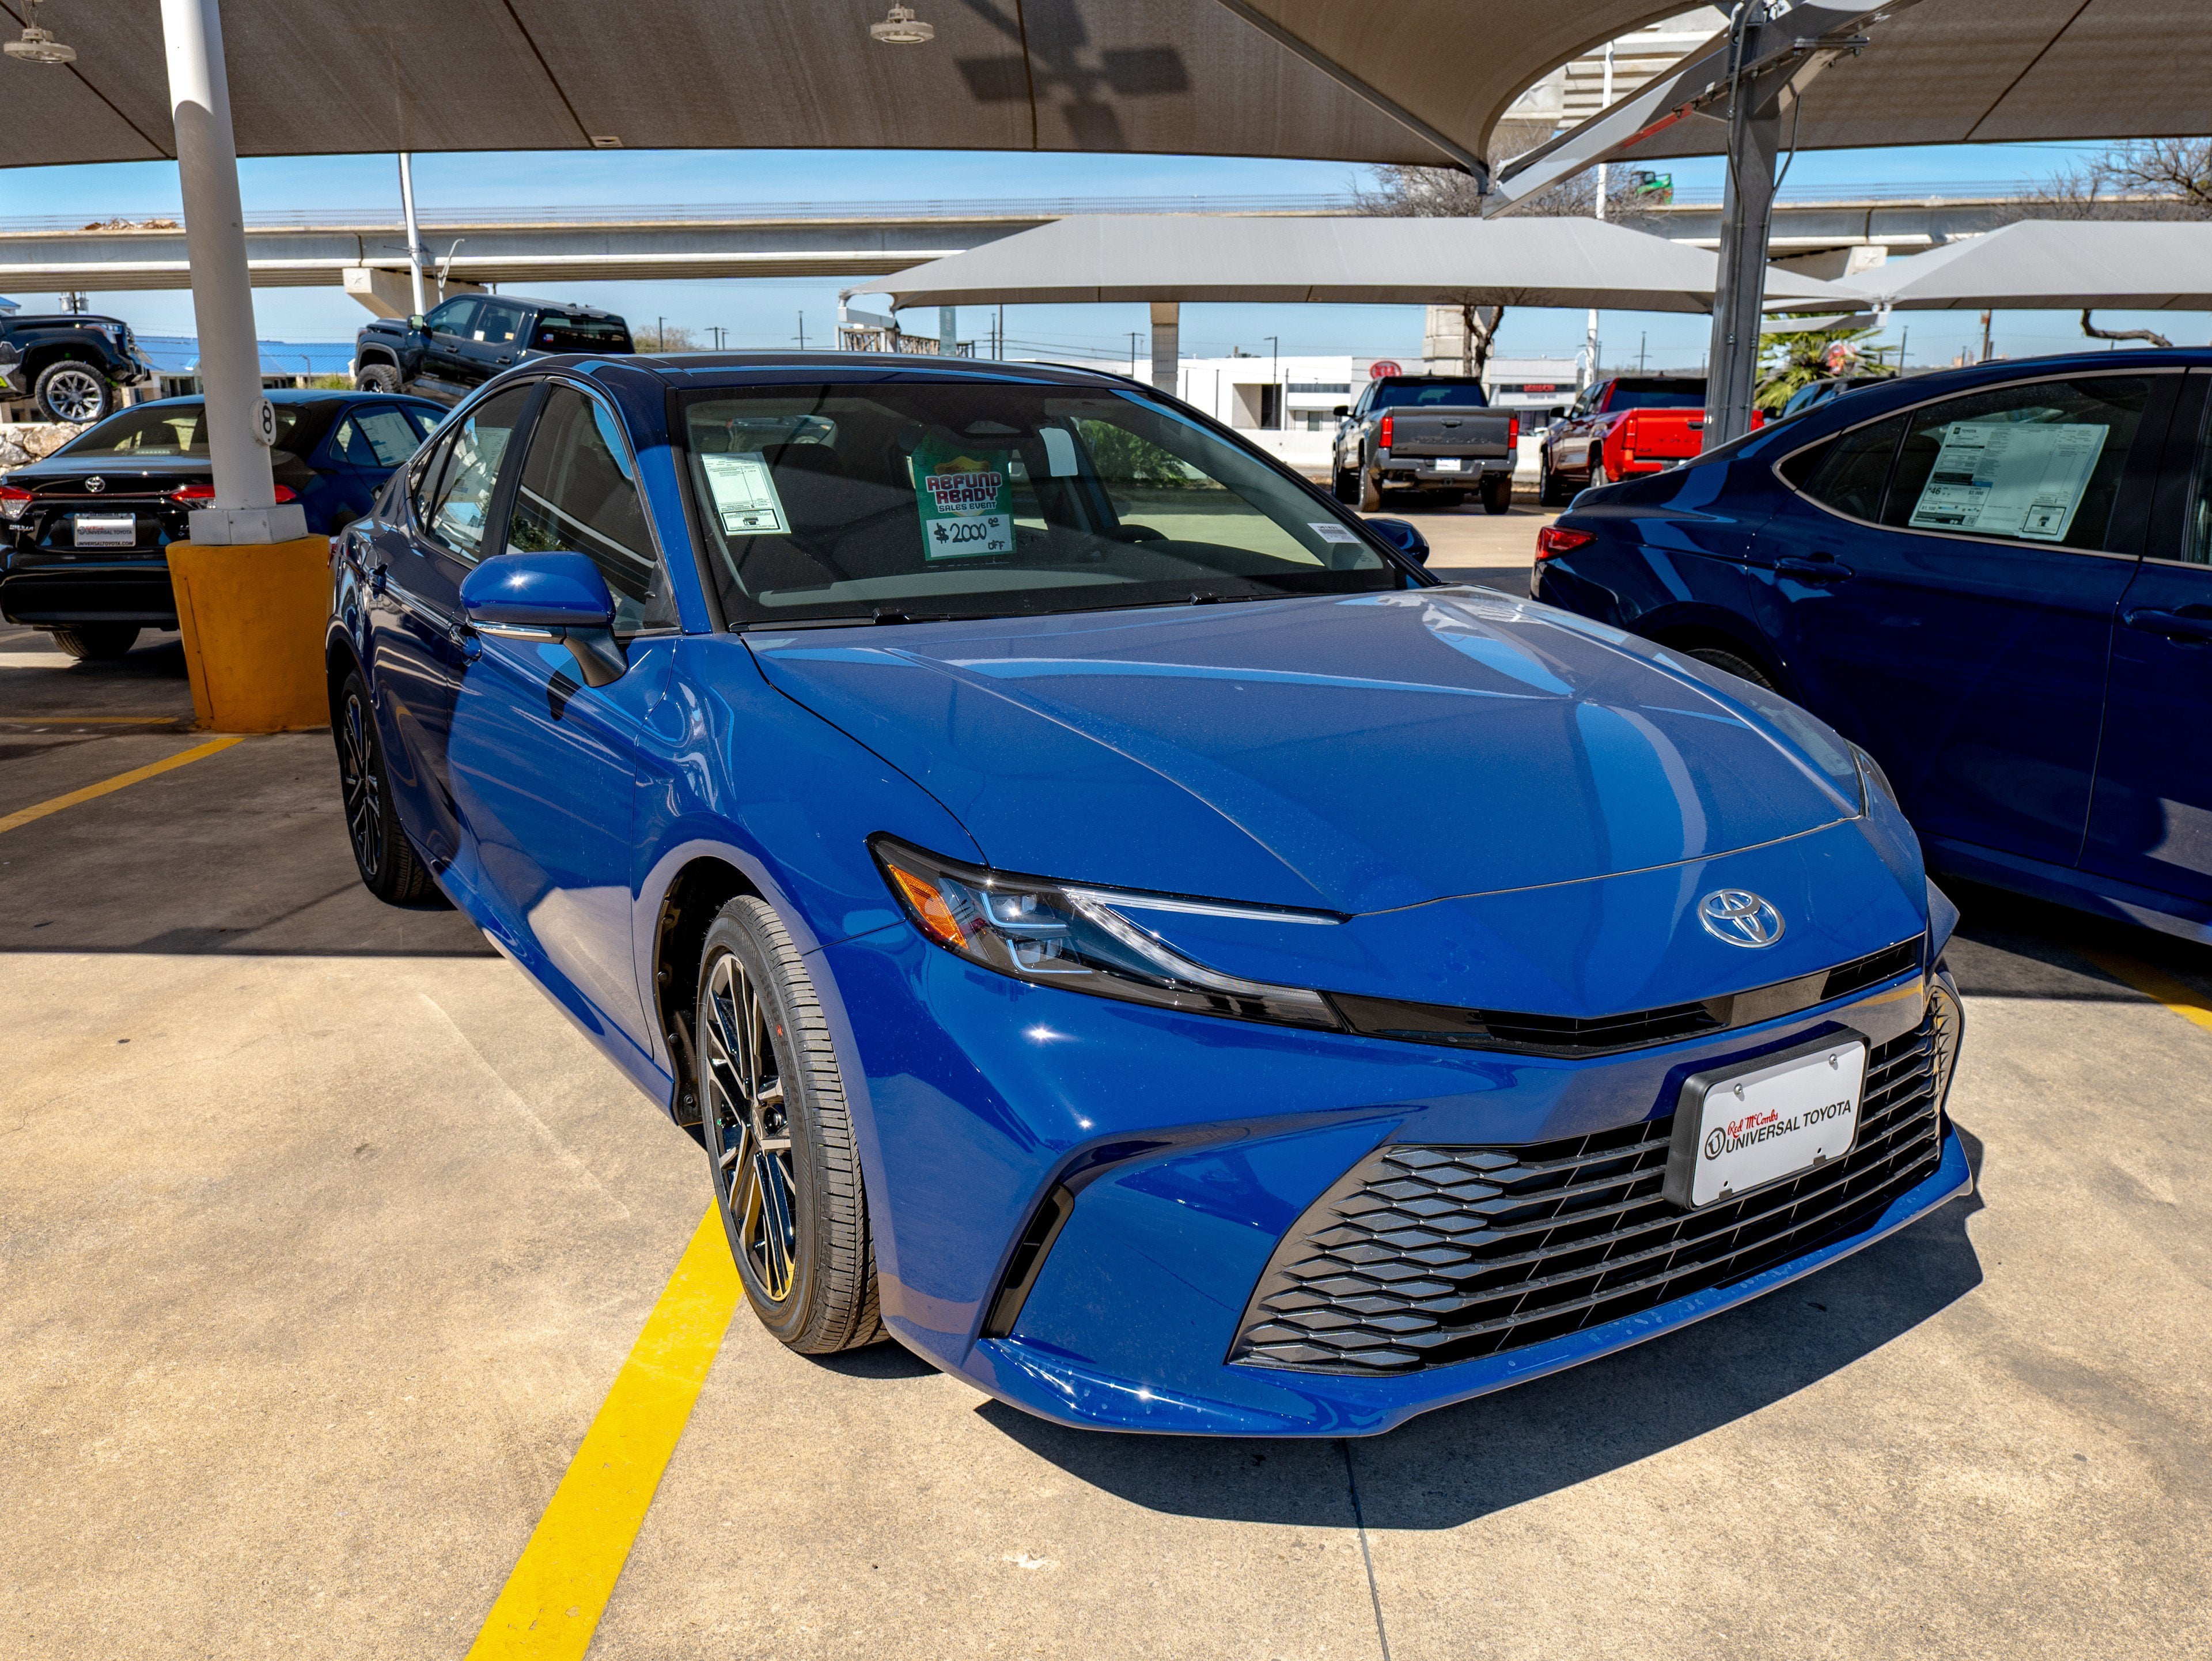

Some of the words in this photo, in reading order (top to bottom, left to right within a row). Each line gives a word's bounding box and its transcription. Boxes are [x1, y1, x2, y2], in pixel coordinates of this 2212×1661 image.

[263, 405, 272, 435] 8
[926, 472, 1002, 491] REFUND
[935, 487, 998, 505] READY
[938, 504, 967, 512] SALES
[969, 501, 997, 510] EVENT
[1726, 1117, 1800, 1153] UNIVERSAL
[1803, 1099, 1851, 1127] TOYOTA
[1728, 1120, 1743, 1139] Red
